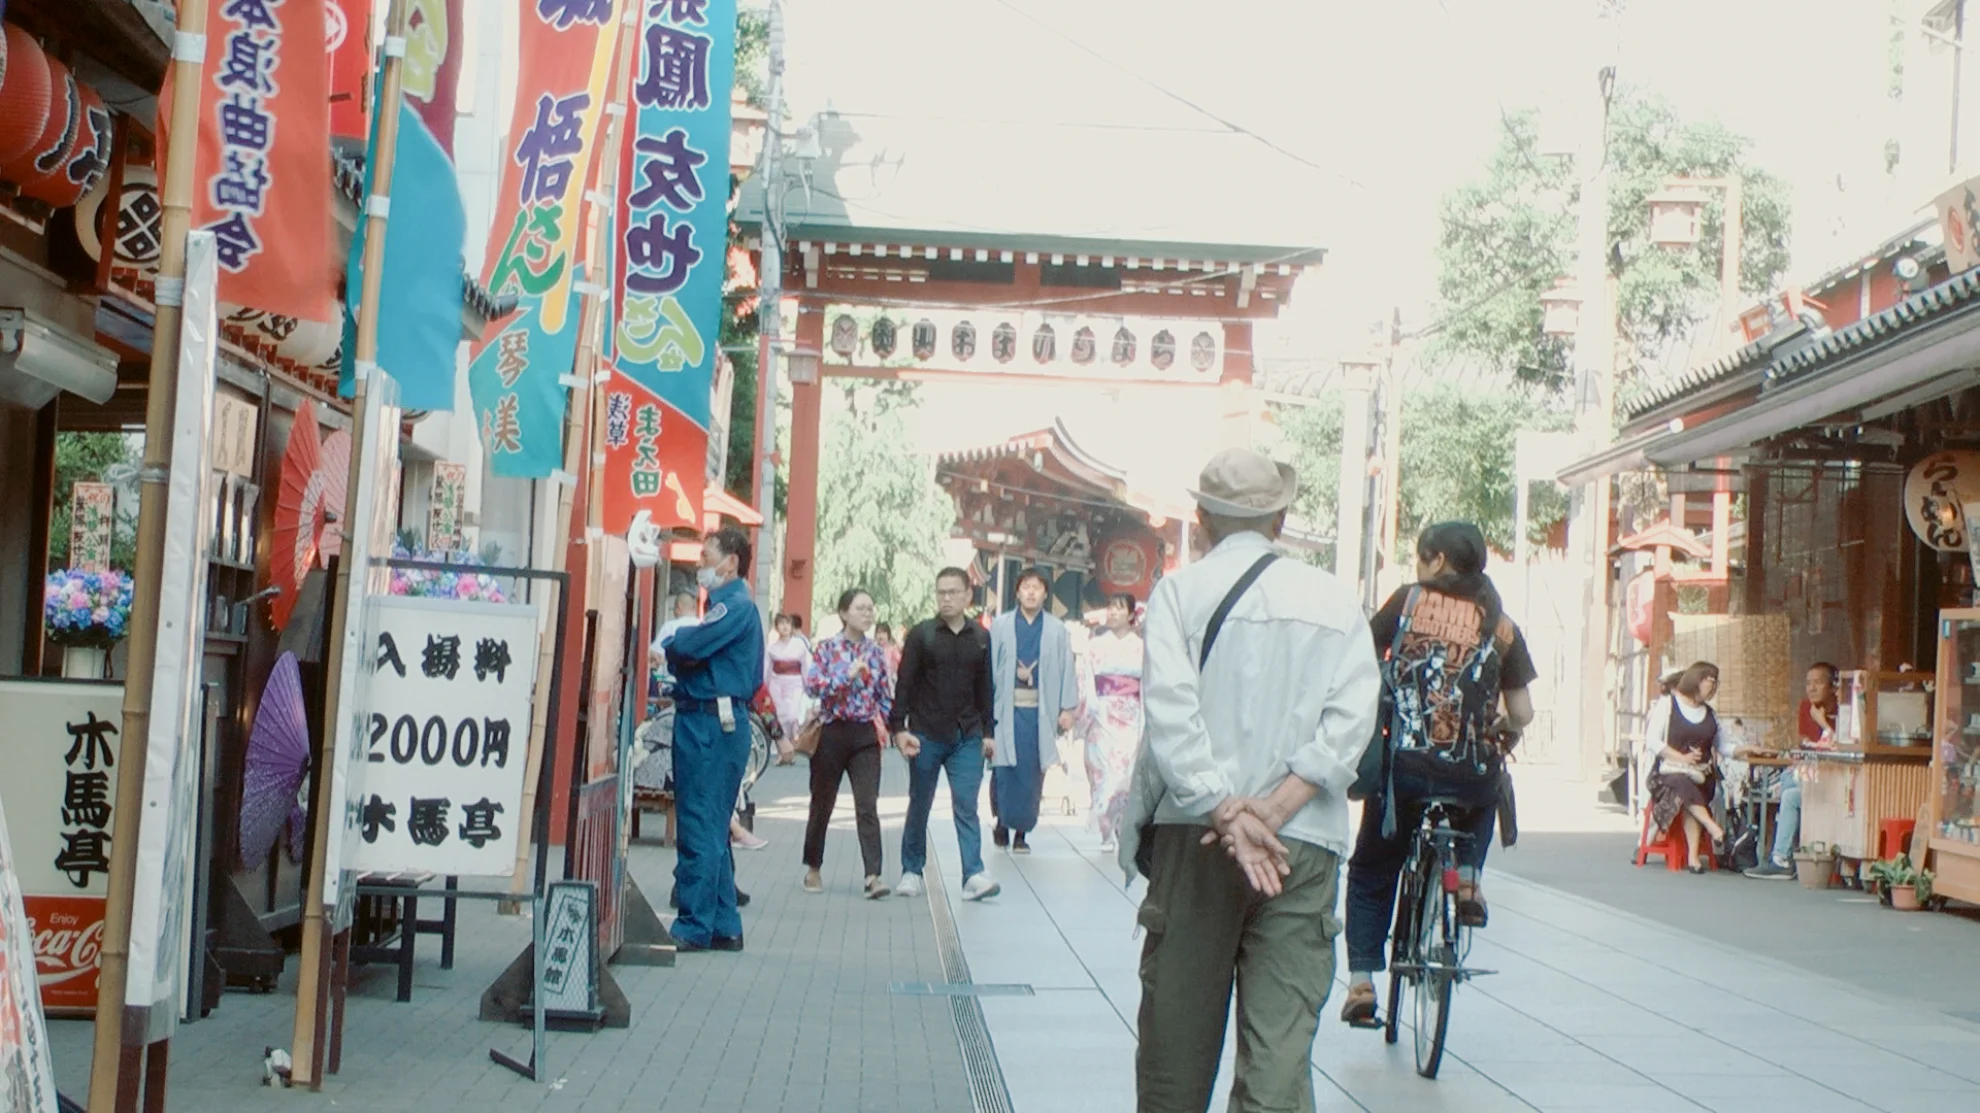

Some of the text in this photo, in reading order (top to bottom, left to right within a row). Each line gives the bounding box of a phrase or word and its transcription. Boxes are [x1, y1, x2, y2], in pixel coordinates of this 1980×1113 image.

[366, 712, 511, 769] 2000円
[54, 710, 119, 890] 木馬亭
[49, 912, 80, 926] Enjoy
